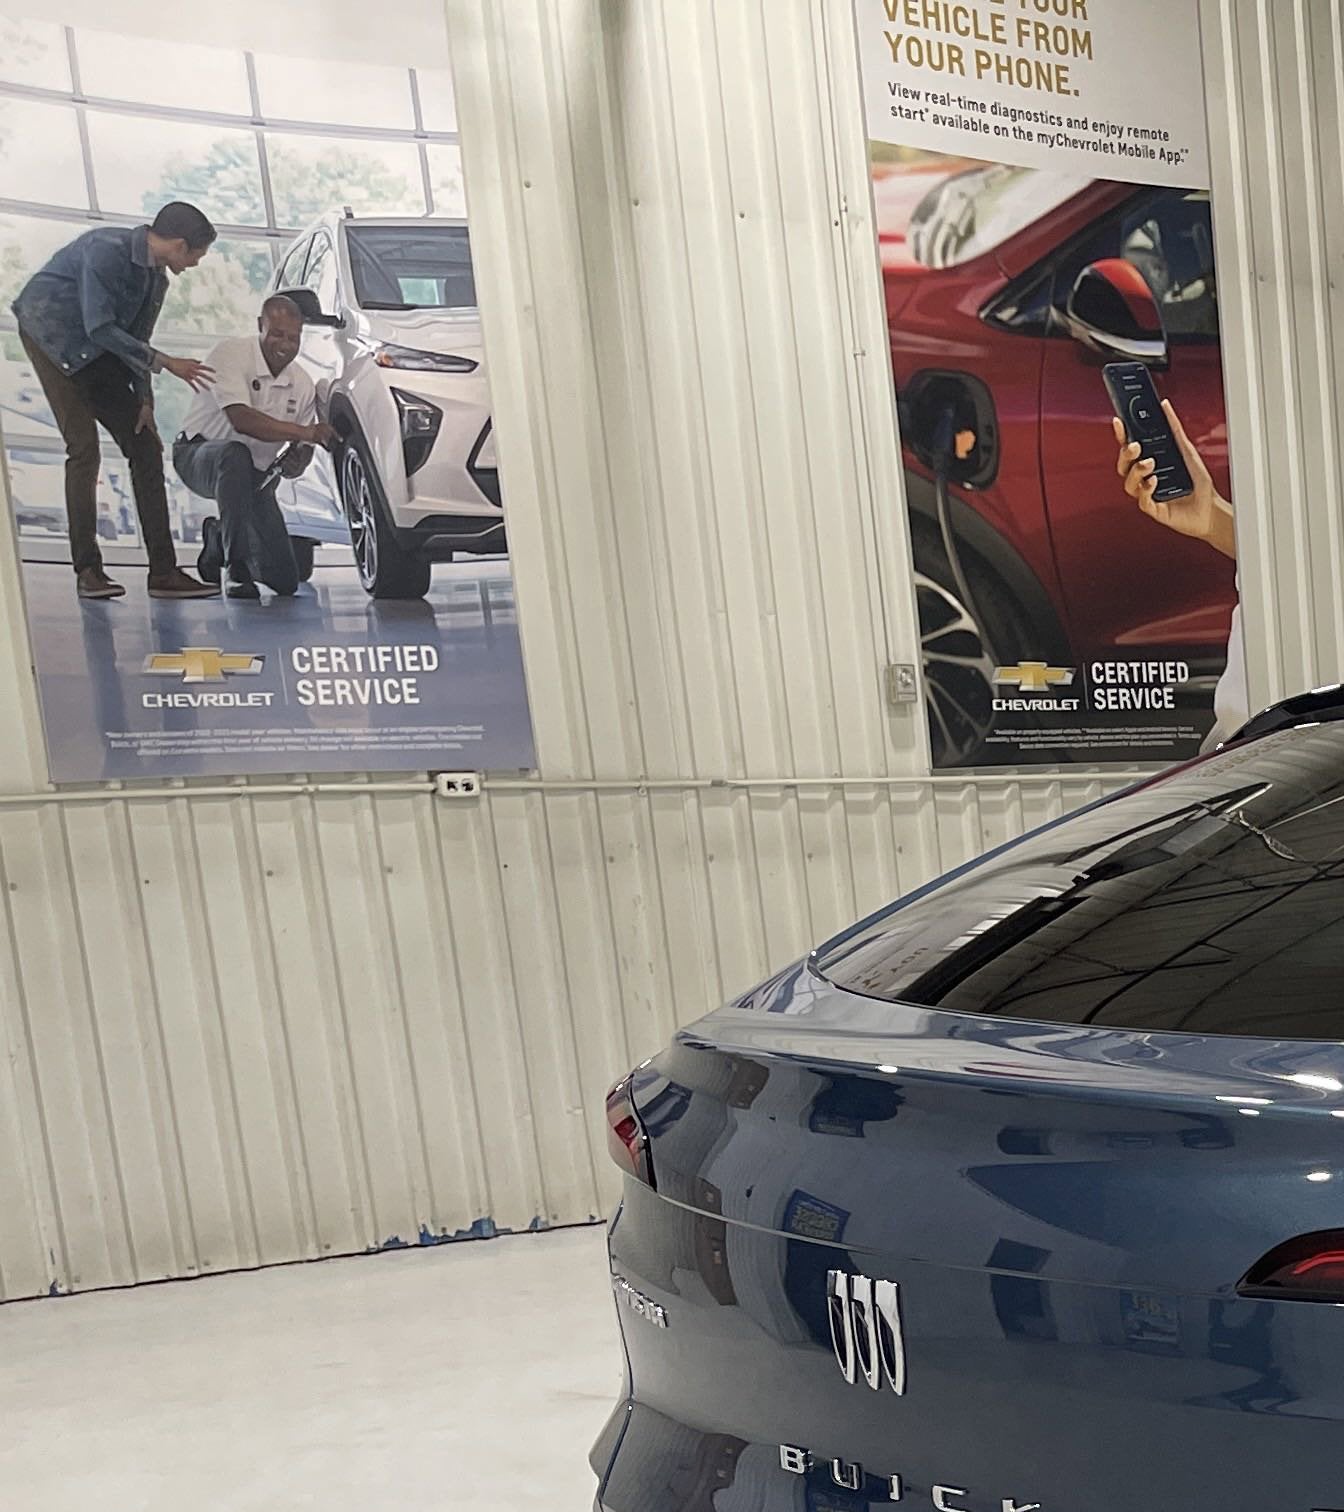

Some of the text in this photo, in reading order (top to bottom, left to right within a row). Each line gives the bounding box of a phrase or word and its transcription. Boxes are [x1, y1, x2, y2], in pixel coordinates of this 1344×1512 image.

[883, 0, 1094, 61] VEHICLE FROM
[883, 31, 1080, 97] YOUR PHONE.
[887, 81, 1170, 142] View real-time diagnostics and enjoy remote
[932, 113, 990, 134] available
[993, 125, 1009, 138] on
[1012, 126, 1034, 142] the
[1037, 131, 1115, 155] myChevrolet
[1118, 142, 1156, 160] Mobile
[291, 645, 439, 675] CERTIFIED
[1091, 661, 1190, 684] CERTIFIED
[142, 692, 275, 708] CHEVROLET
[296, 677, 421, 706] SERVICE
[991, 698, 1080, 712] CHEVROLET
[1093, 687, 1176, 711] SERVICE
